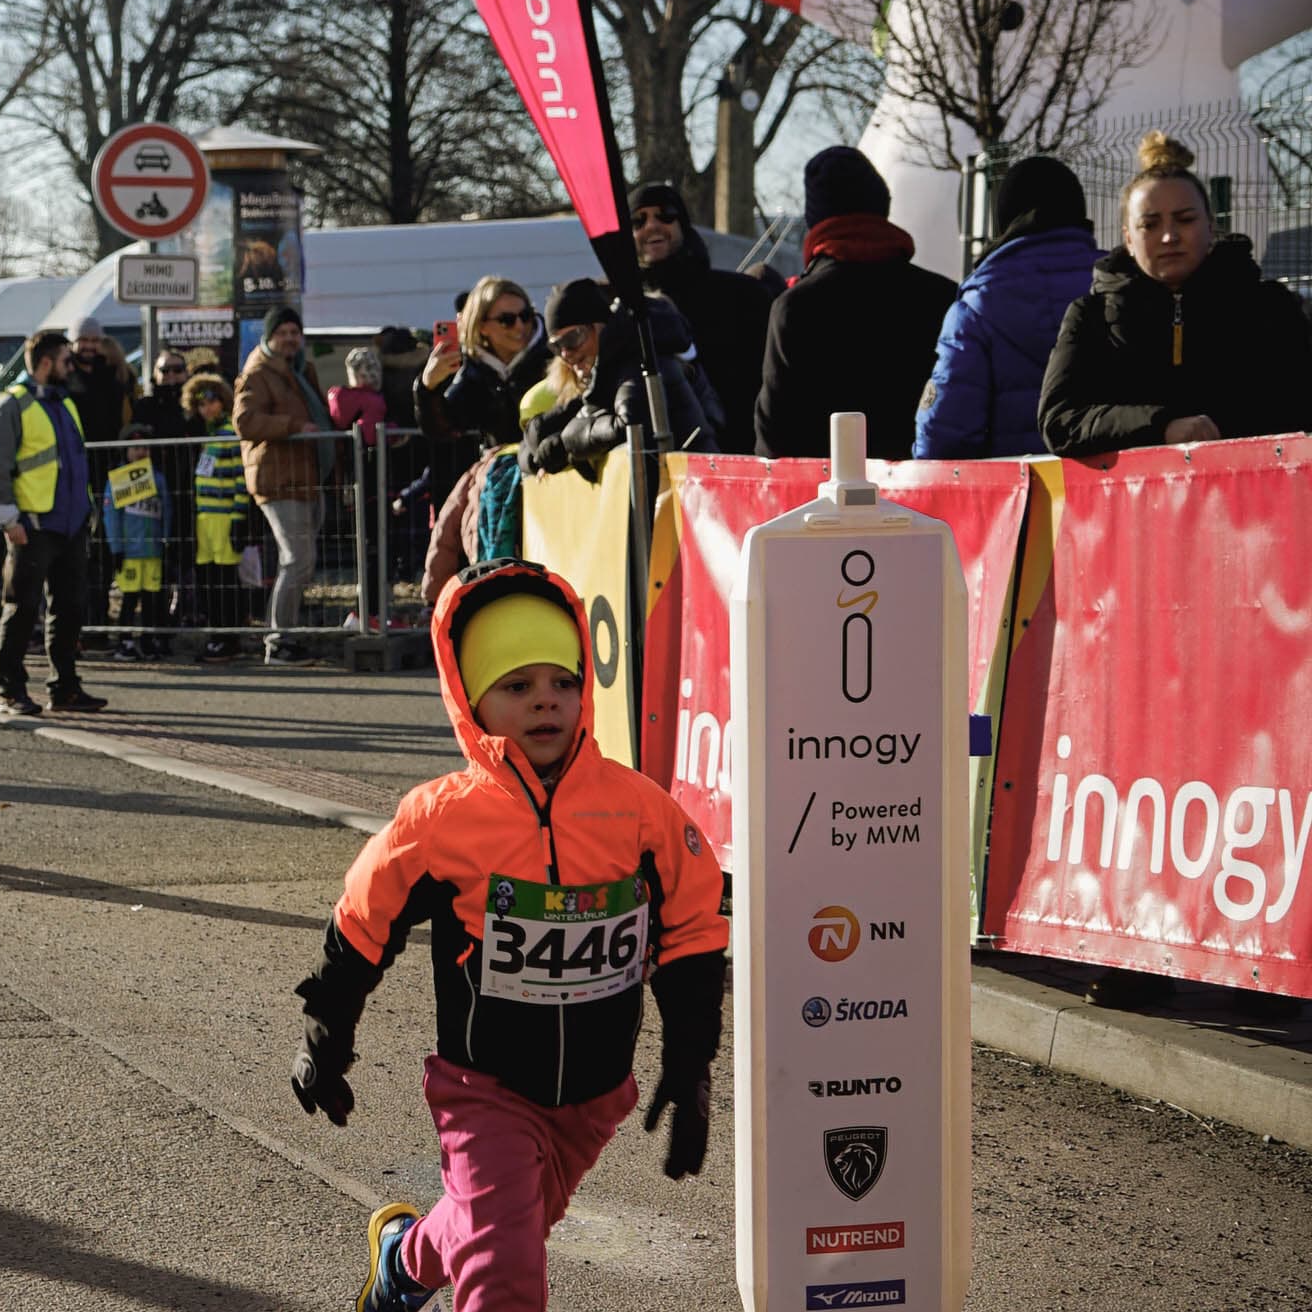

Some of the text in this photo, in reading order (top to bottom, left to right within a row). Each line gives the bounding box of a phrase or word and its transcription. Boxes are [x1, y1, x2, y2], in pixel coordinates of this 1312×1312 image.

[788, 728, 922, 765] innogy
[831, 797, 922, 821] Powered
[831, 824, 921, 851] by MVM
[1047, 734, 1312, 923] innogy
[869, 920, 905, 942] NN
[489, 914, 639, 979] 3446
[835, 997, 909, 1022] ŠKODA
[826, 1076, 903, 1098] RUNTO
[828, 1132, 882, 1144] PEUGEOT
[811, 1227, 901, 1250] NUTREND
